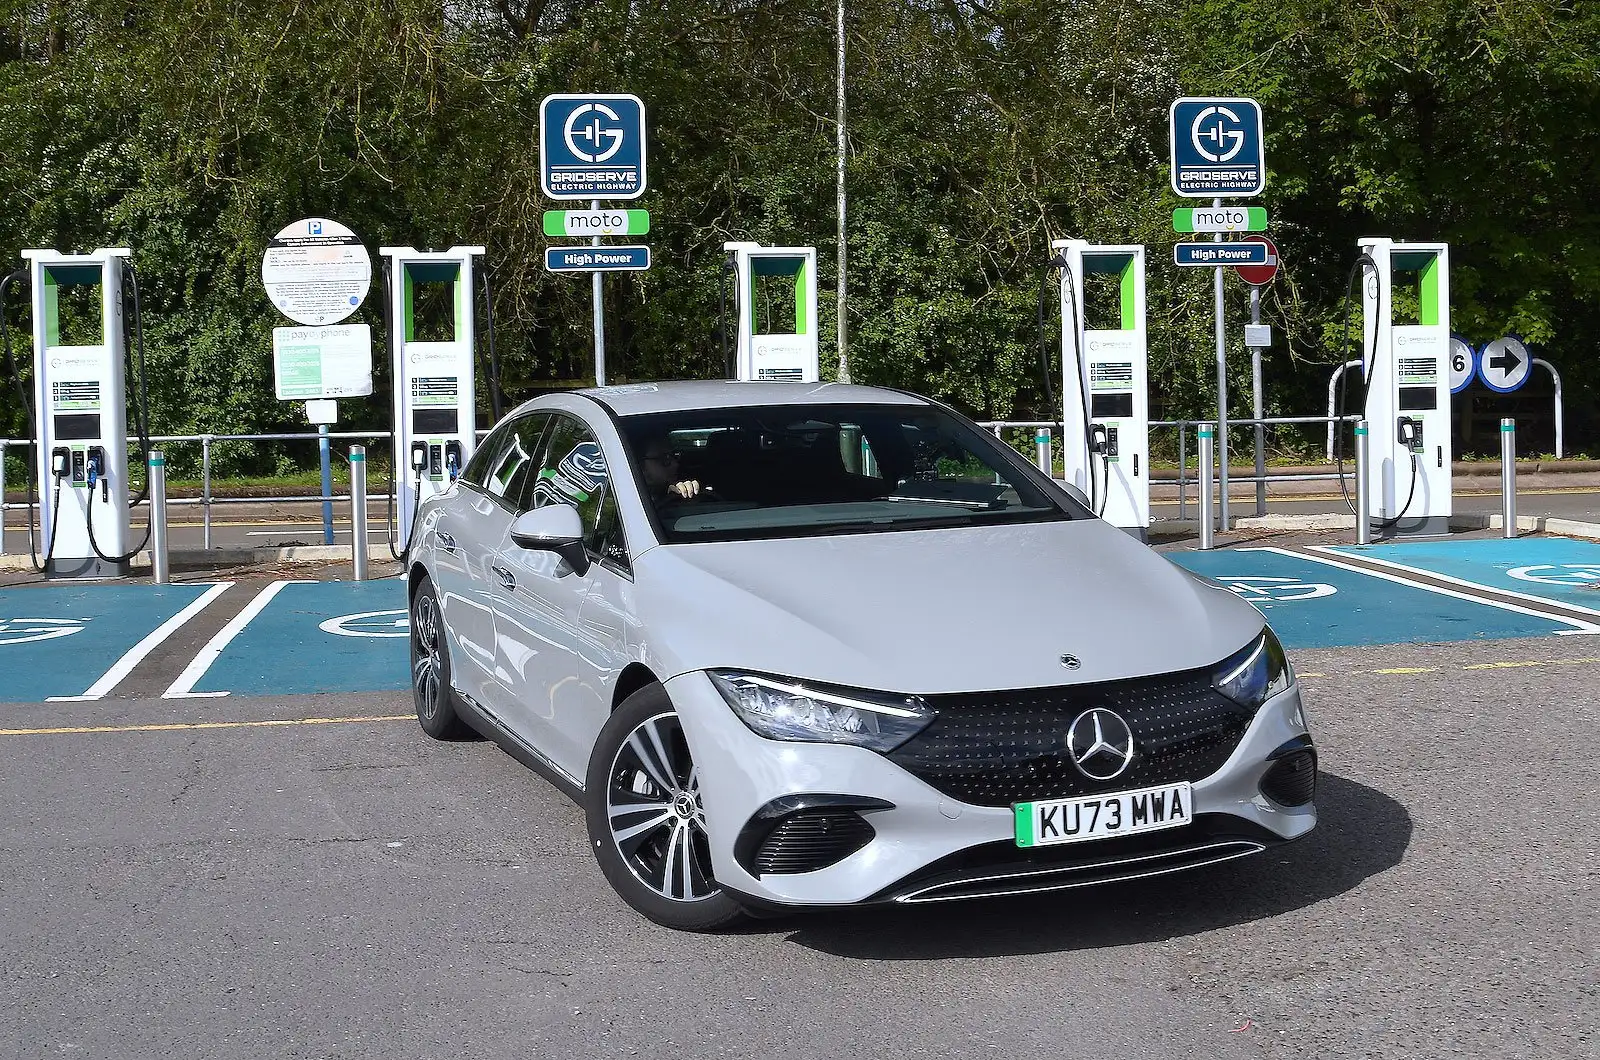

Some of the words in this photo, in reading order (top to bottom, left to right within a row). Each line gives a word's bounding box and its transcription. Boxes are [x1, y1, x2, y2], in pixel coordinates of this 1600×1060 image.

[550, 171, 637, 182] GRIDSERVE
[1180, 171, 1257, 181] GRIDSERVE
[550, 183, 594, 191] ELECTRIC
[597, 182, 637, 190] HIGHWAY
[1180, 181, 1218, 189] ELECTRIC
[1221, 181, 1257, 189] HIGHWAY
[570, 212, 623, 228] moto
[1197, 210, 1244, 225] moto
[564, 253, 592, 266] High
[595, 253, 633, 264] Power
[1191, 249, 1217, 261] High
[1218, 249, 1252, 260] Power
[1040, 798, 1122, 839] KU73
[1131, 788, 1185, 827] MWA
